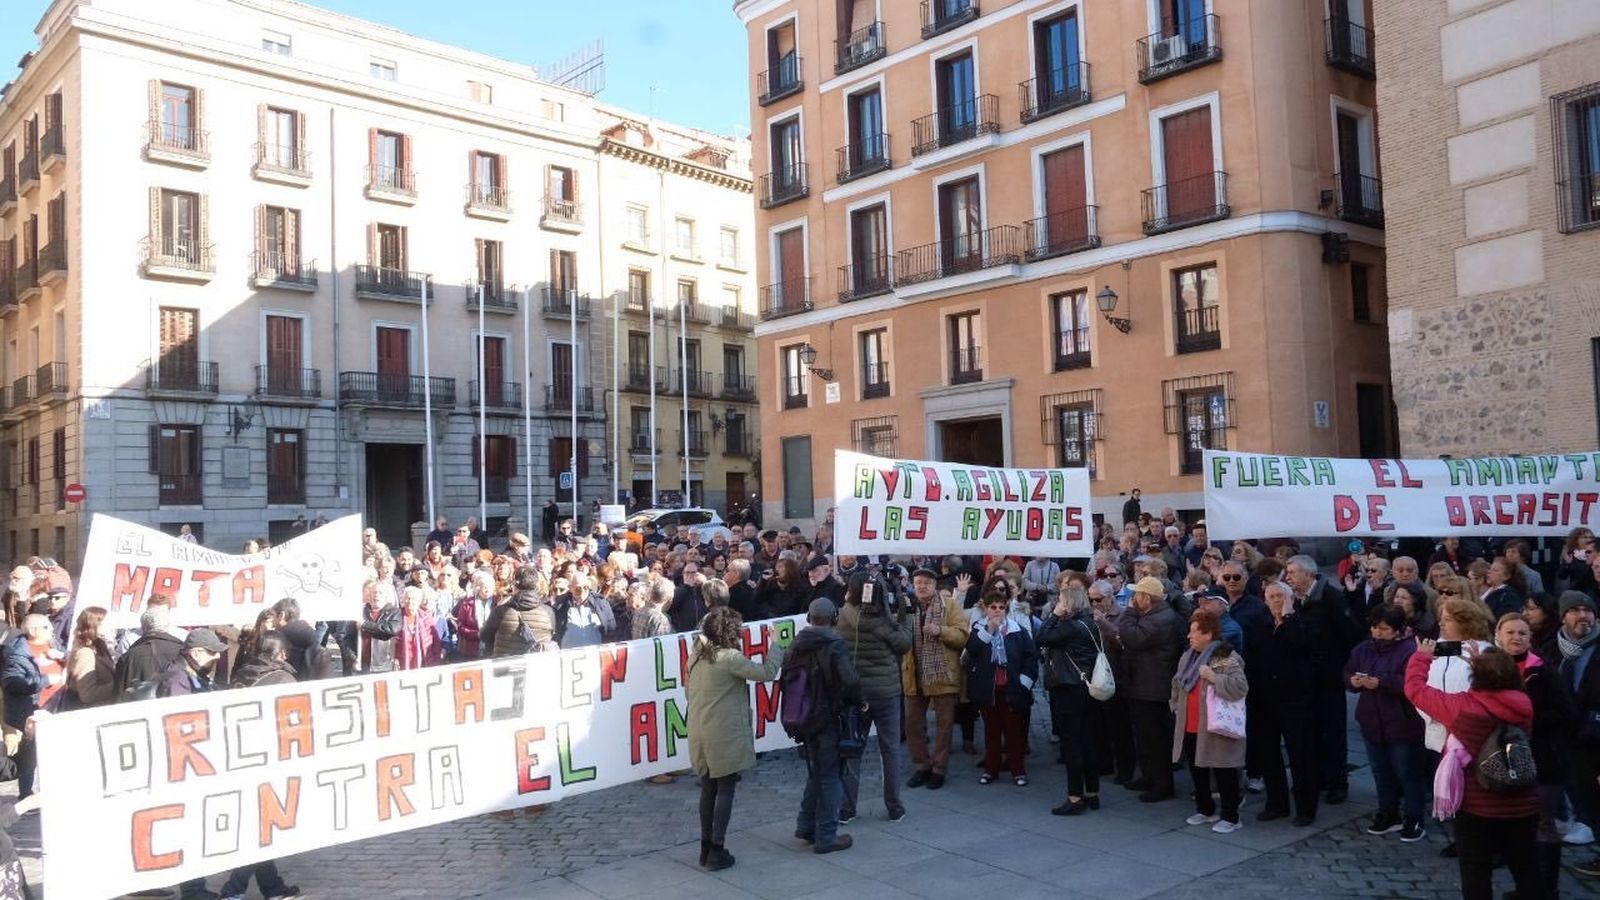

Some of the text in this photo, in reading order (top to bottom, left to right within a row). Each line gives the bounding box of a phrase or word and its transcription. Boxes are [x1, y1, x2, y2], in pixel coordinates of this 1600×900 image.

[952, 469, 1064, 503] AGILIZA
[1212, 453, 1600, 488] FUERA EL AMIANT
[859, 506, 929, 540] LAS
[1332, 492, 1599, 532] DE ORCASIT
[111, 563, 266, 612] MATA
[560, 641, 628, 709] EN
[654, 619, 795, 693] LHA
[131, 745, 464, 871] CONTRA
[515, 722, 597, 795] EL
